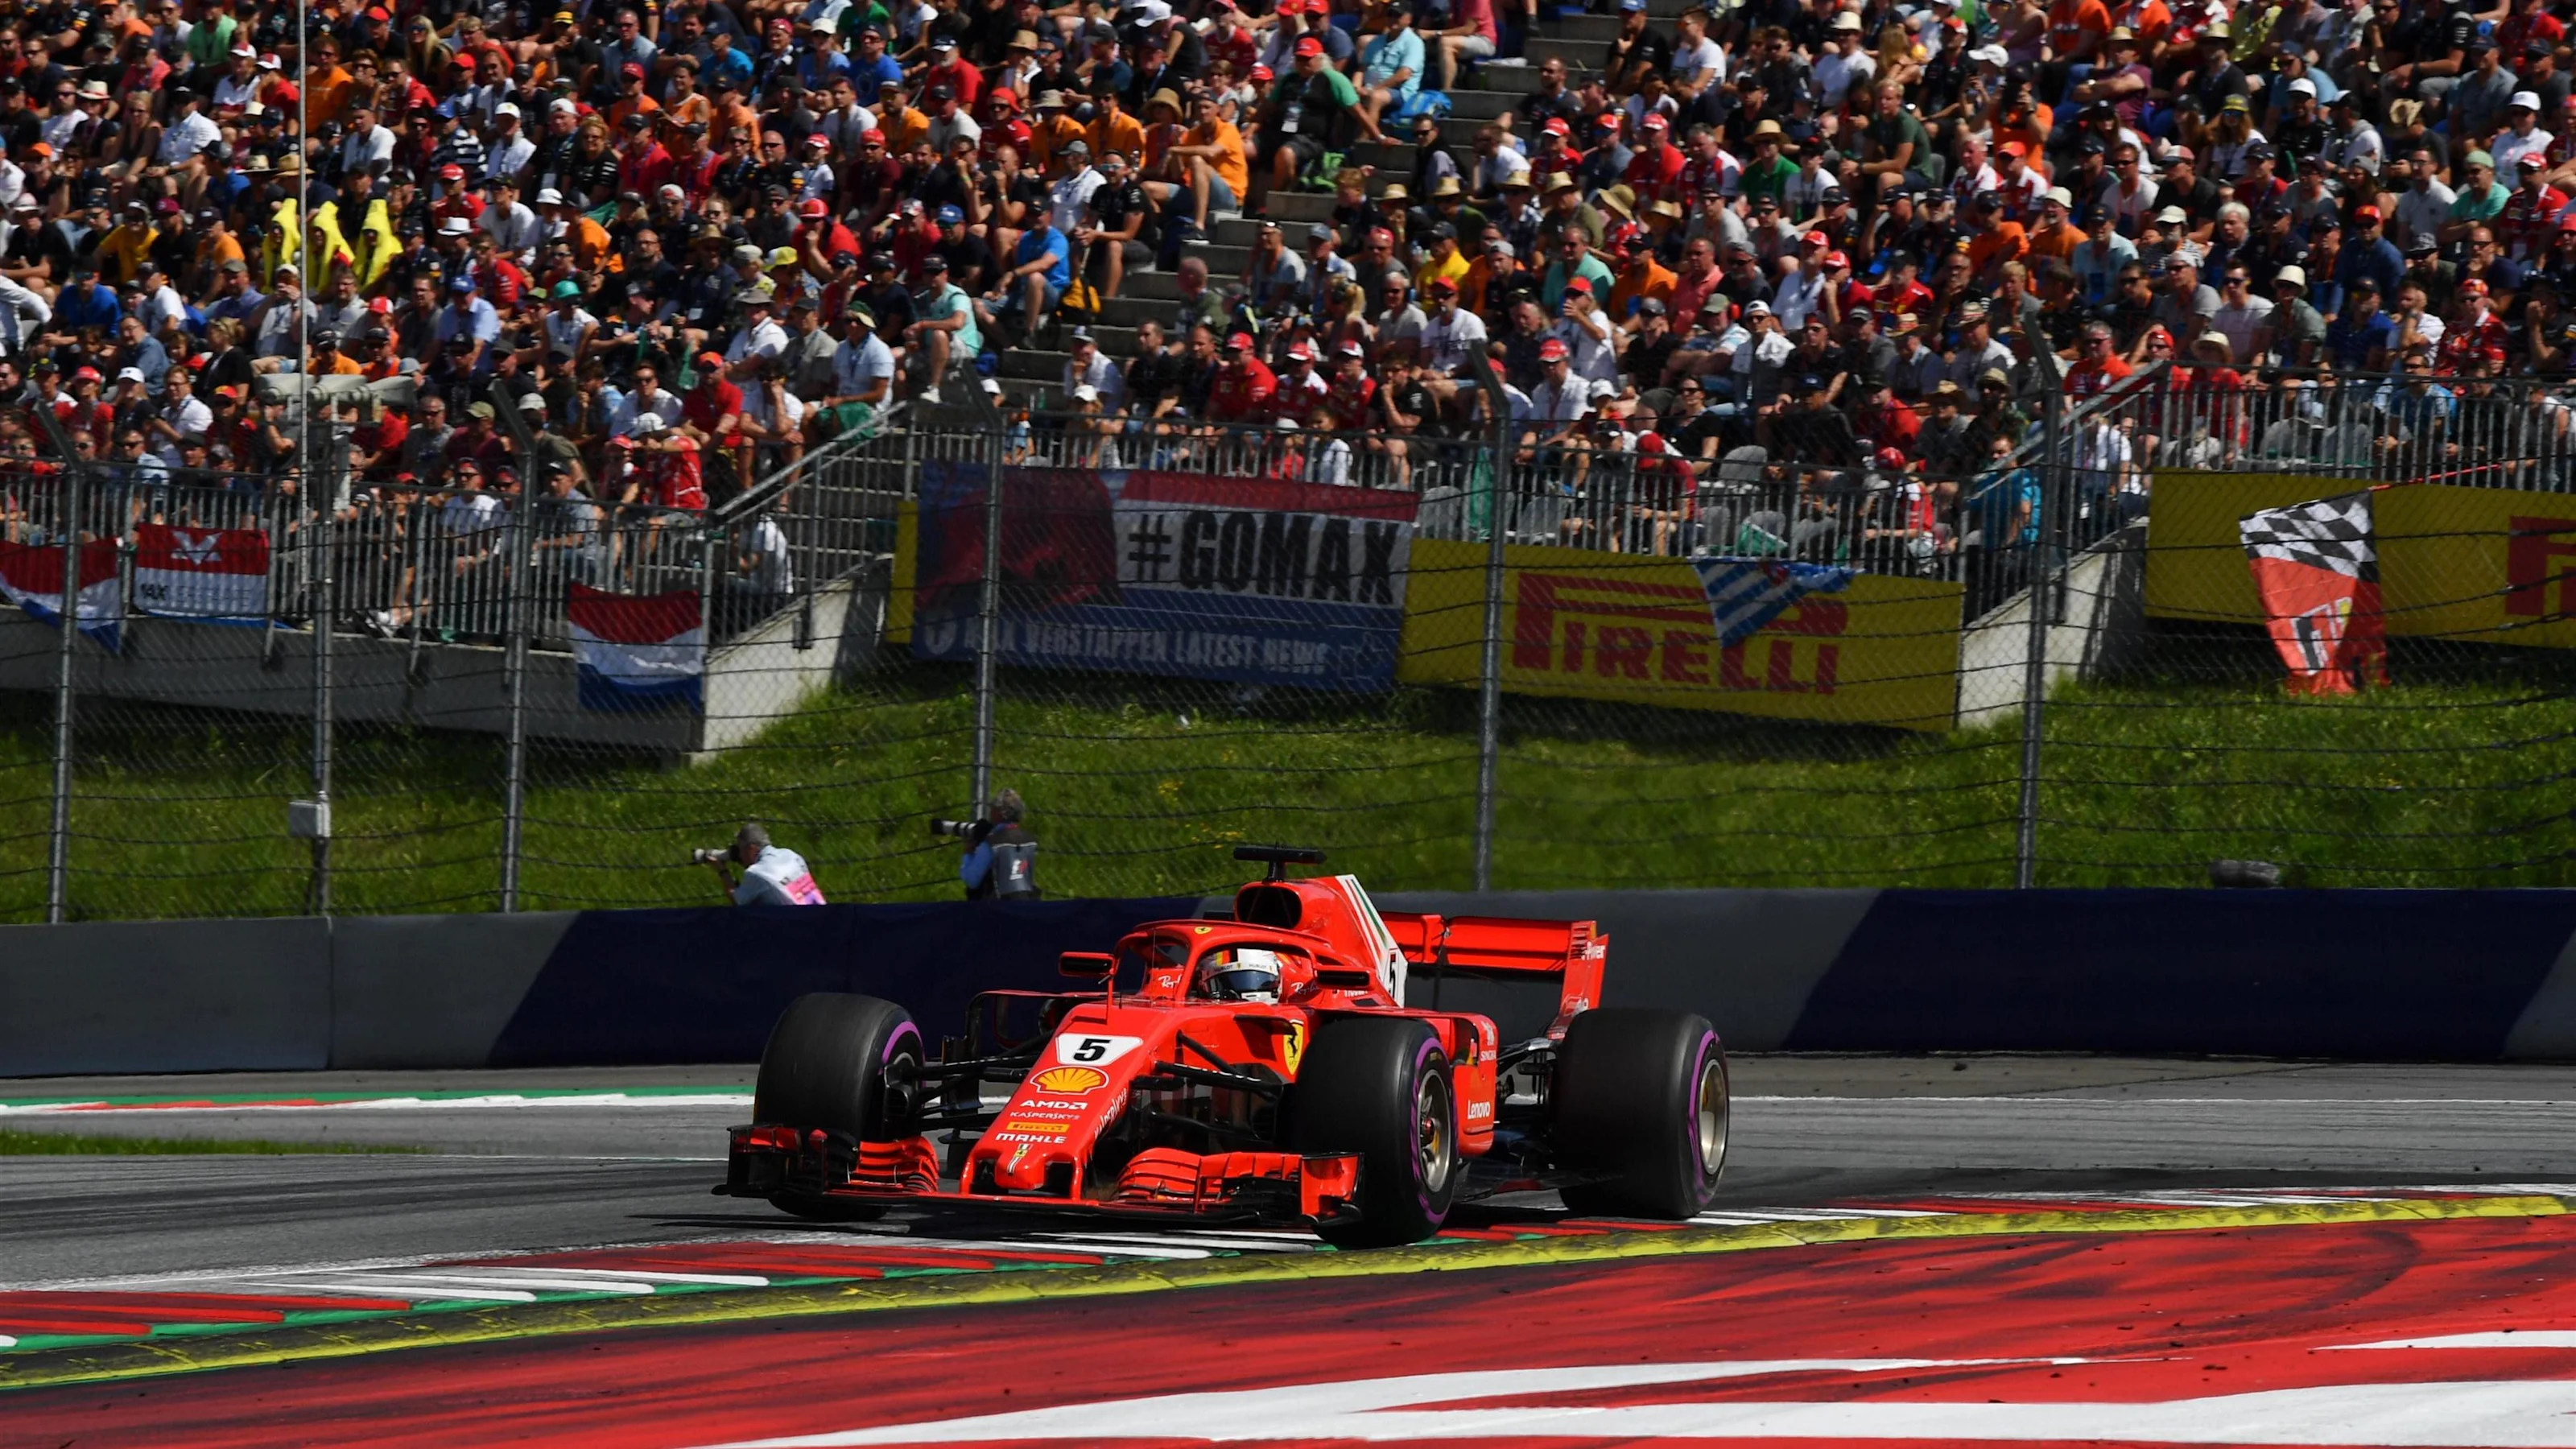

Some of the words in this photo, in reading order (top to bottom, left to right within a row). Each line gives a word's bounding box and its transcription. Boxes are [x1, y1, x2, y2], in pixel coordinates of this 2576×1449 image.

[1127, 510, 1399, 604] #GOMAX
[1513, 572, 1849, 696] PIRELLI
[1174, 630, 1257, 668] LATEST
[1073, 1038, 1113, 1062] 5
[1019, 1100, 1072, 1110] AMD
[1467, 1099, 1491, 1120] Lenovo
[995, 1133, 1067, 1144] MAHLE
